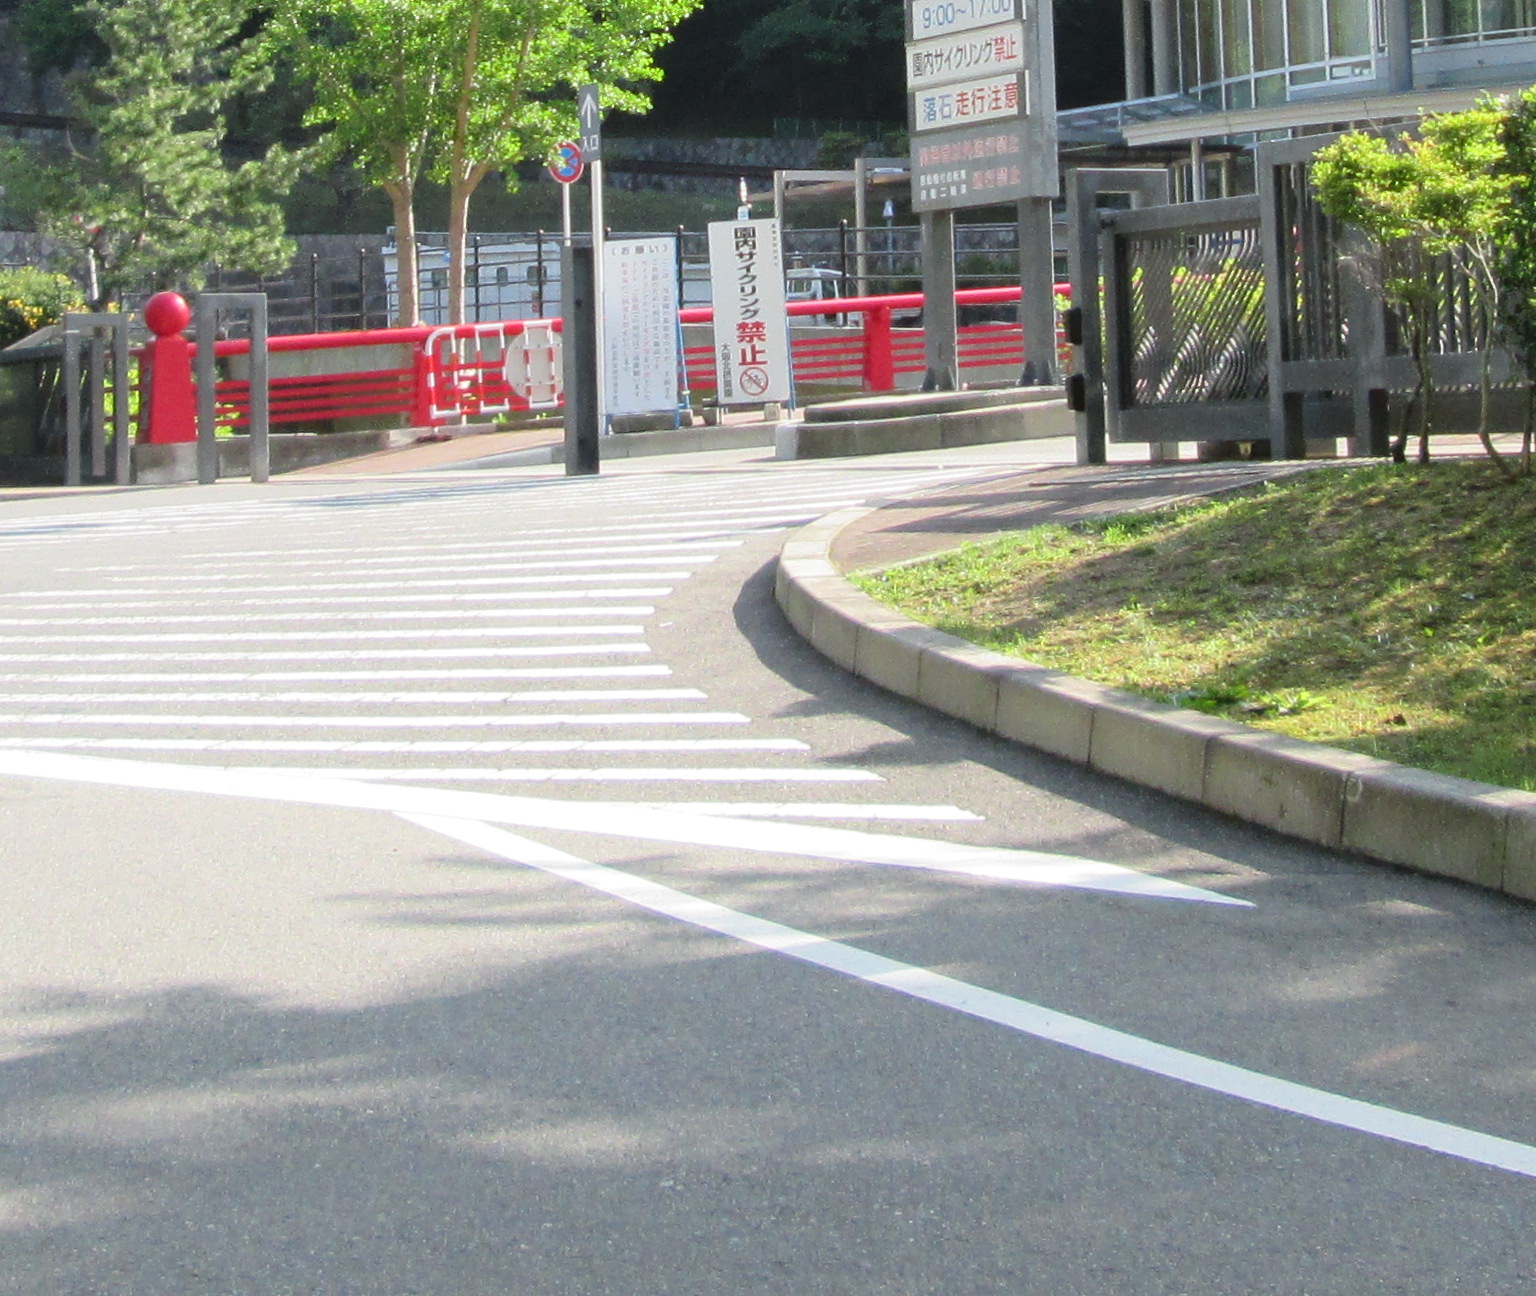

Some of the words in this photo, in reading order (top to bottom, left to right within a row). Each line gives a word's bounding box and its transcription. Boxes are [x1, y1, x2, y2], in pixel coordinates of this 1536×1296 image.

[913, 34, 1017, 77] 園内サイクリング禁止
[582, 135, 599, 152] 入口
[733, 226, 768, 366] 園内サイクリング禁止
